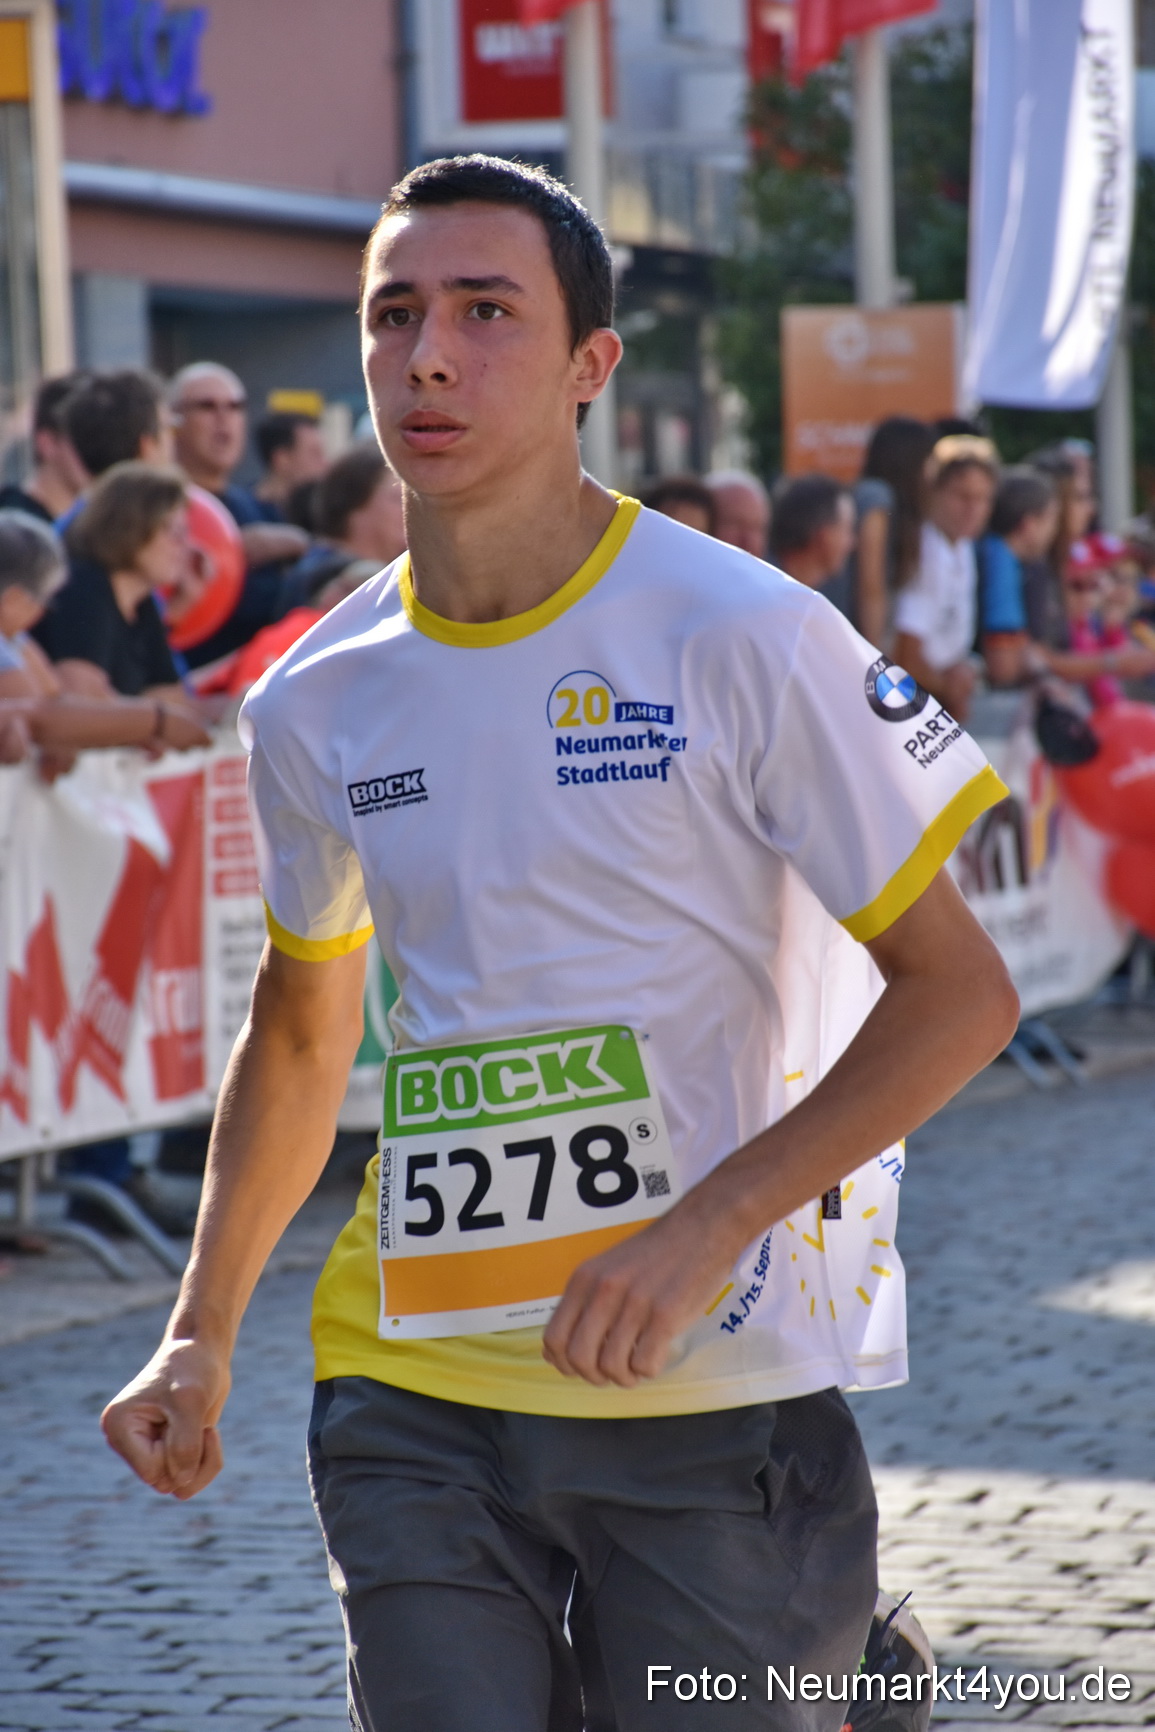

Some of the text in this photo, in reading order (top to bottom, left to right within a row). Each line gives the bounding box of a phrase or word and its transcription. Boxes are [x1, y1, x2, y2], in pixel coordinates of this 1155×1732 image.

[555, 686, 669, 729] 20 JAHRE
[555, 729, 688, 757] Neumarkter
[904, 708, 954, 759] PART
[347, 768, 427, 809] BOCK
[556, 756, 672, 787] Stadtlauf
[397, 1036, 625, 1126] BOCK
[636, 1123, 650, 1138] S
[404, 1125, 639, 1238] 5278
[720, 1282, 764, 1335] 14./15.
